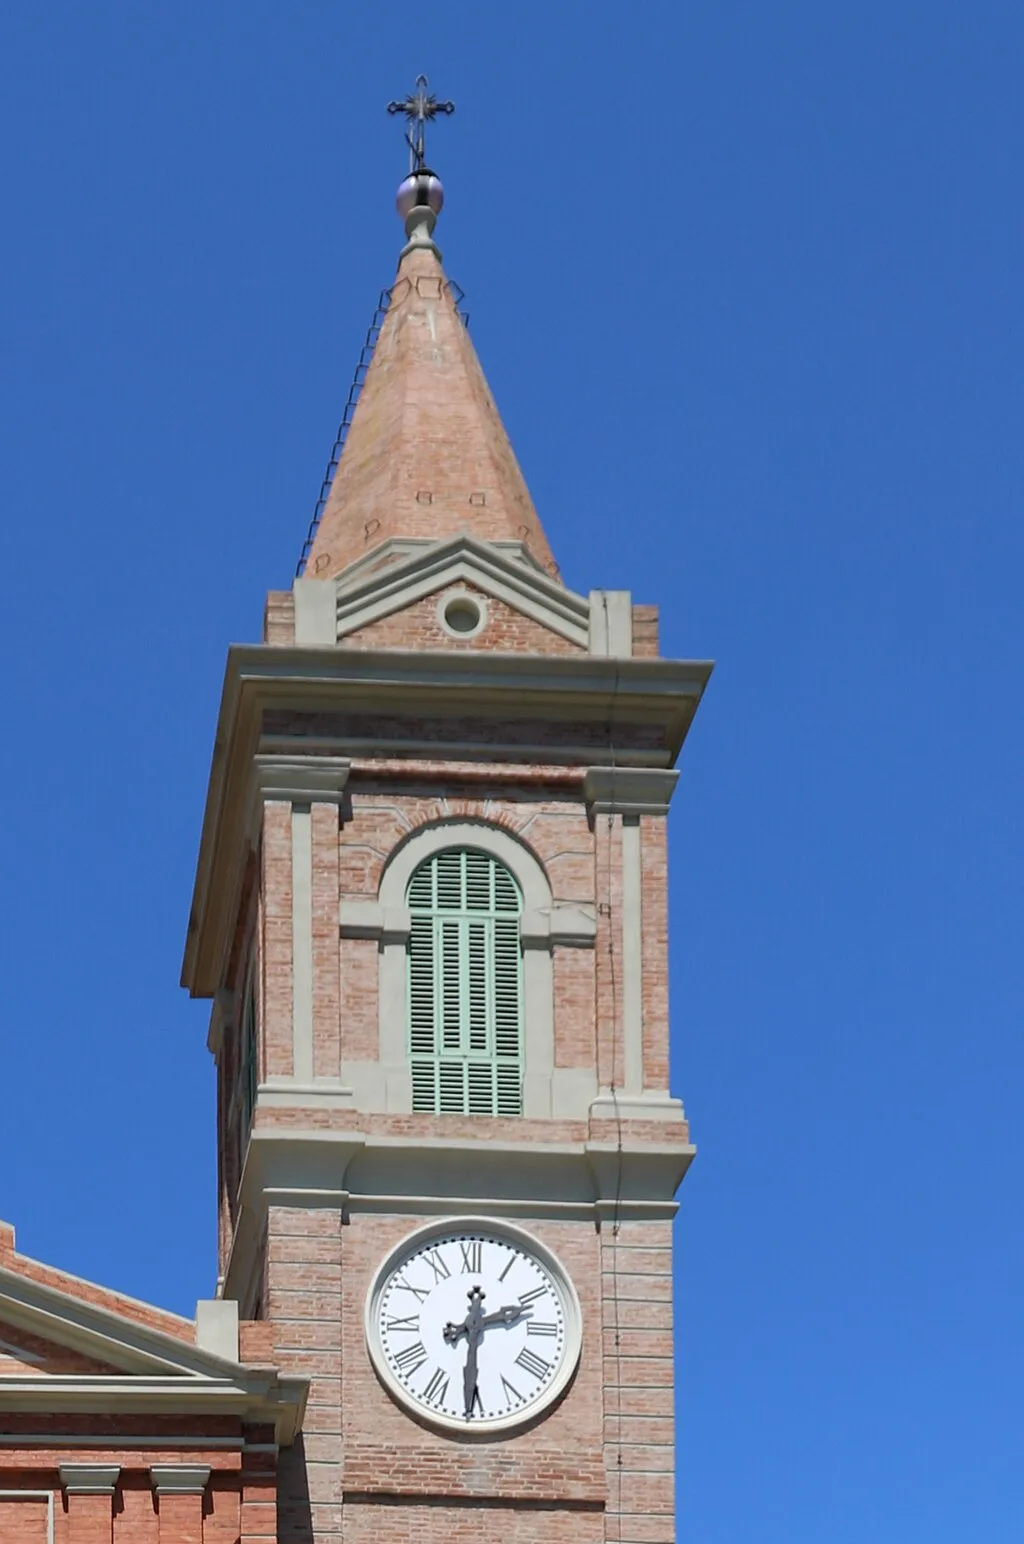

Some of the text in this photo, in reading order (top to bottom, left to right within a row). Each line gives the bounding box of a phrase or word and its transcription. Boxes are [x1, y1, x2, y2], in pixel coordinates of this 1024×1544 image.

[421, 1249, 451, 1285] XI
[460, 1242, 482, 1274] XII
[497, 1254, 519, 1283] I
[394, 1276, 430, 1304] X
[518, 1285, 548, 1305] II
[386, 1314, 419, 1332] IX
[526, 1321, 557, 1337] III
[393, 1341, 429, 1380] VIII
[514, 1347, 553, 1380] IIII
[423, 1366, 451, 1406] VII
[499, 1372, 527, 1406] V
